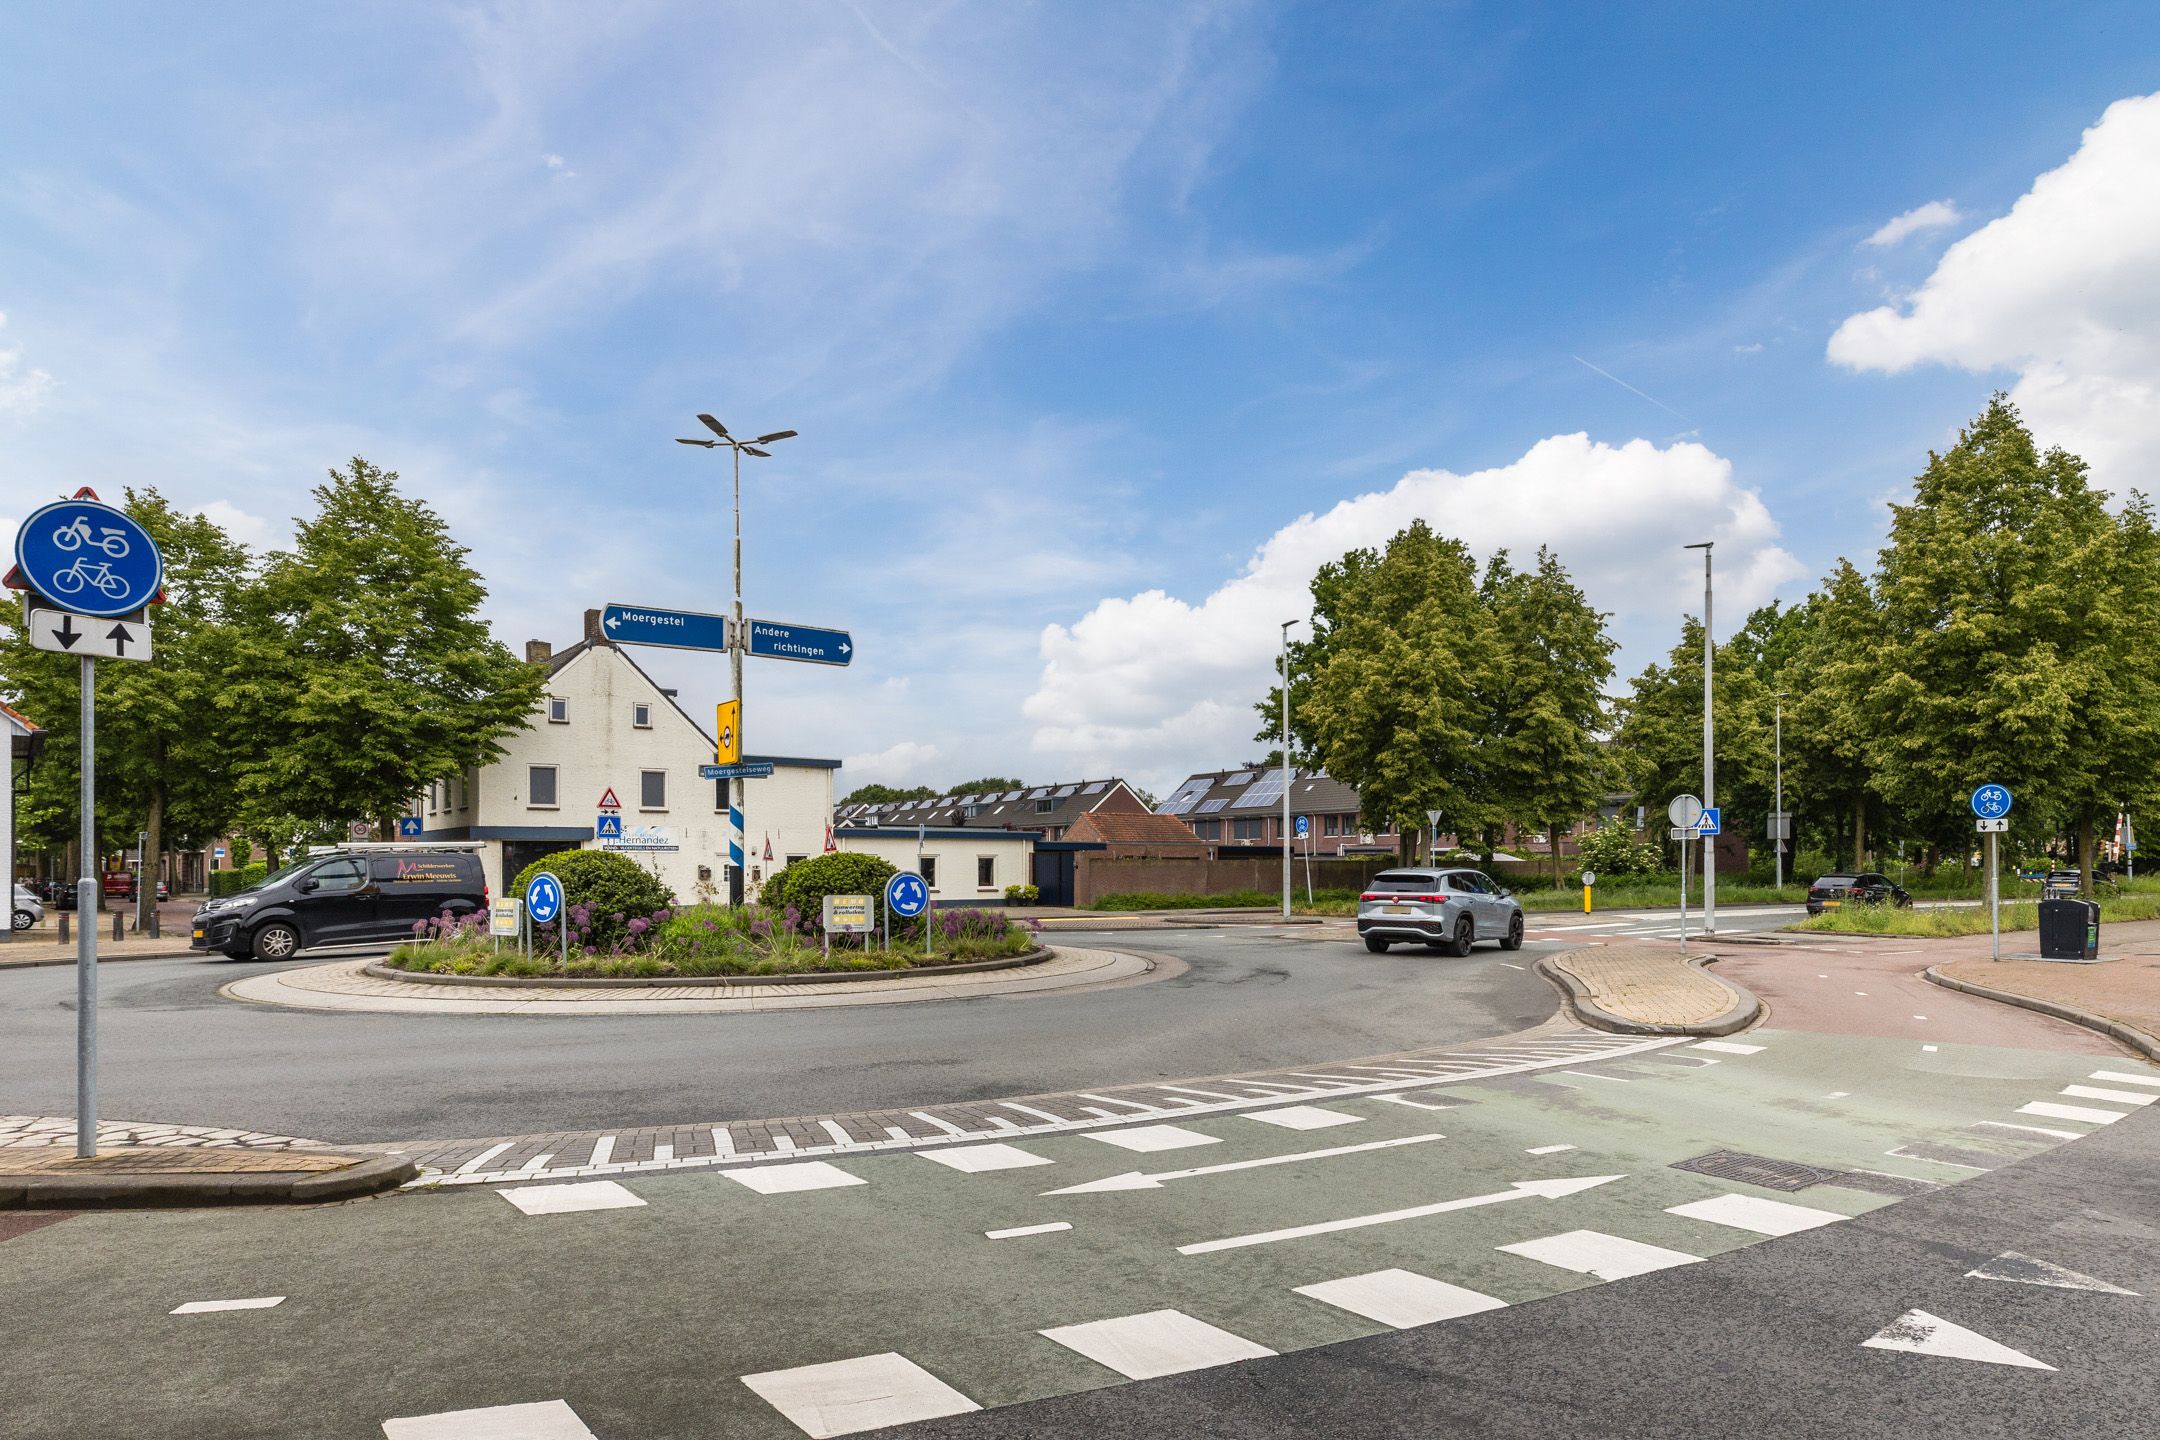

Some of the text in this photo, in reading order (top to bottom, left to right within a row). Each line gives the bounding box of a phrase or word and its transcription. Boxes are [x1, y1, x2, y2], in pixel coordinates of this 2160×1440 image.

[622, 611, 684, 626] Moergestel
[754, 626, 790, 638] Andere
[773, 642, 824, 656] richtingen
[707, 766, 771, 776] Moergestelseweg
[620, 835, 669, 845] Hernandez
